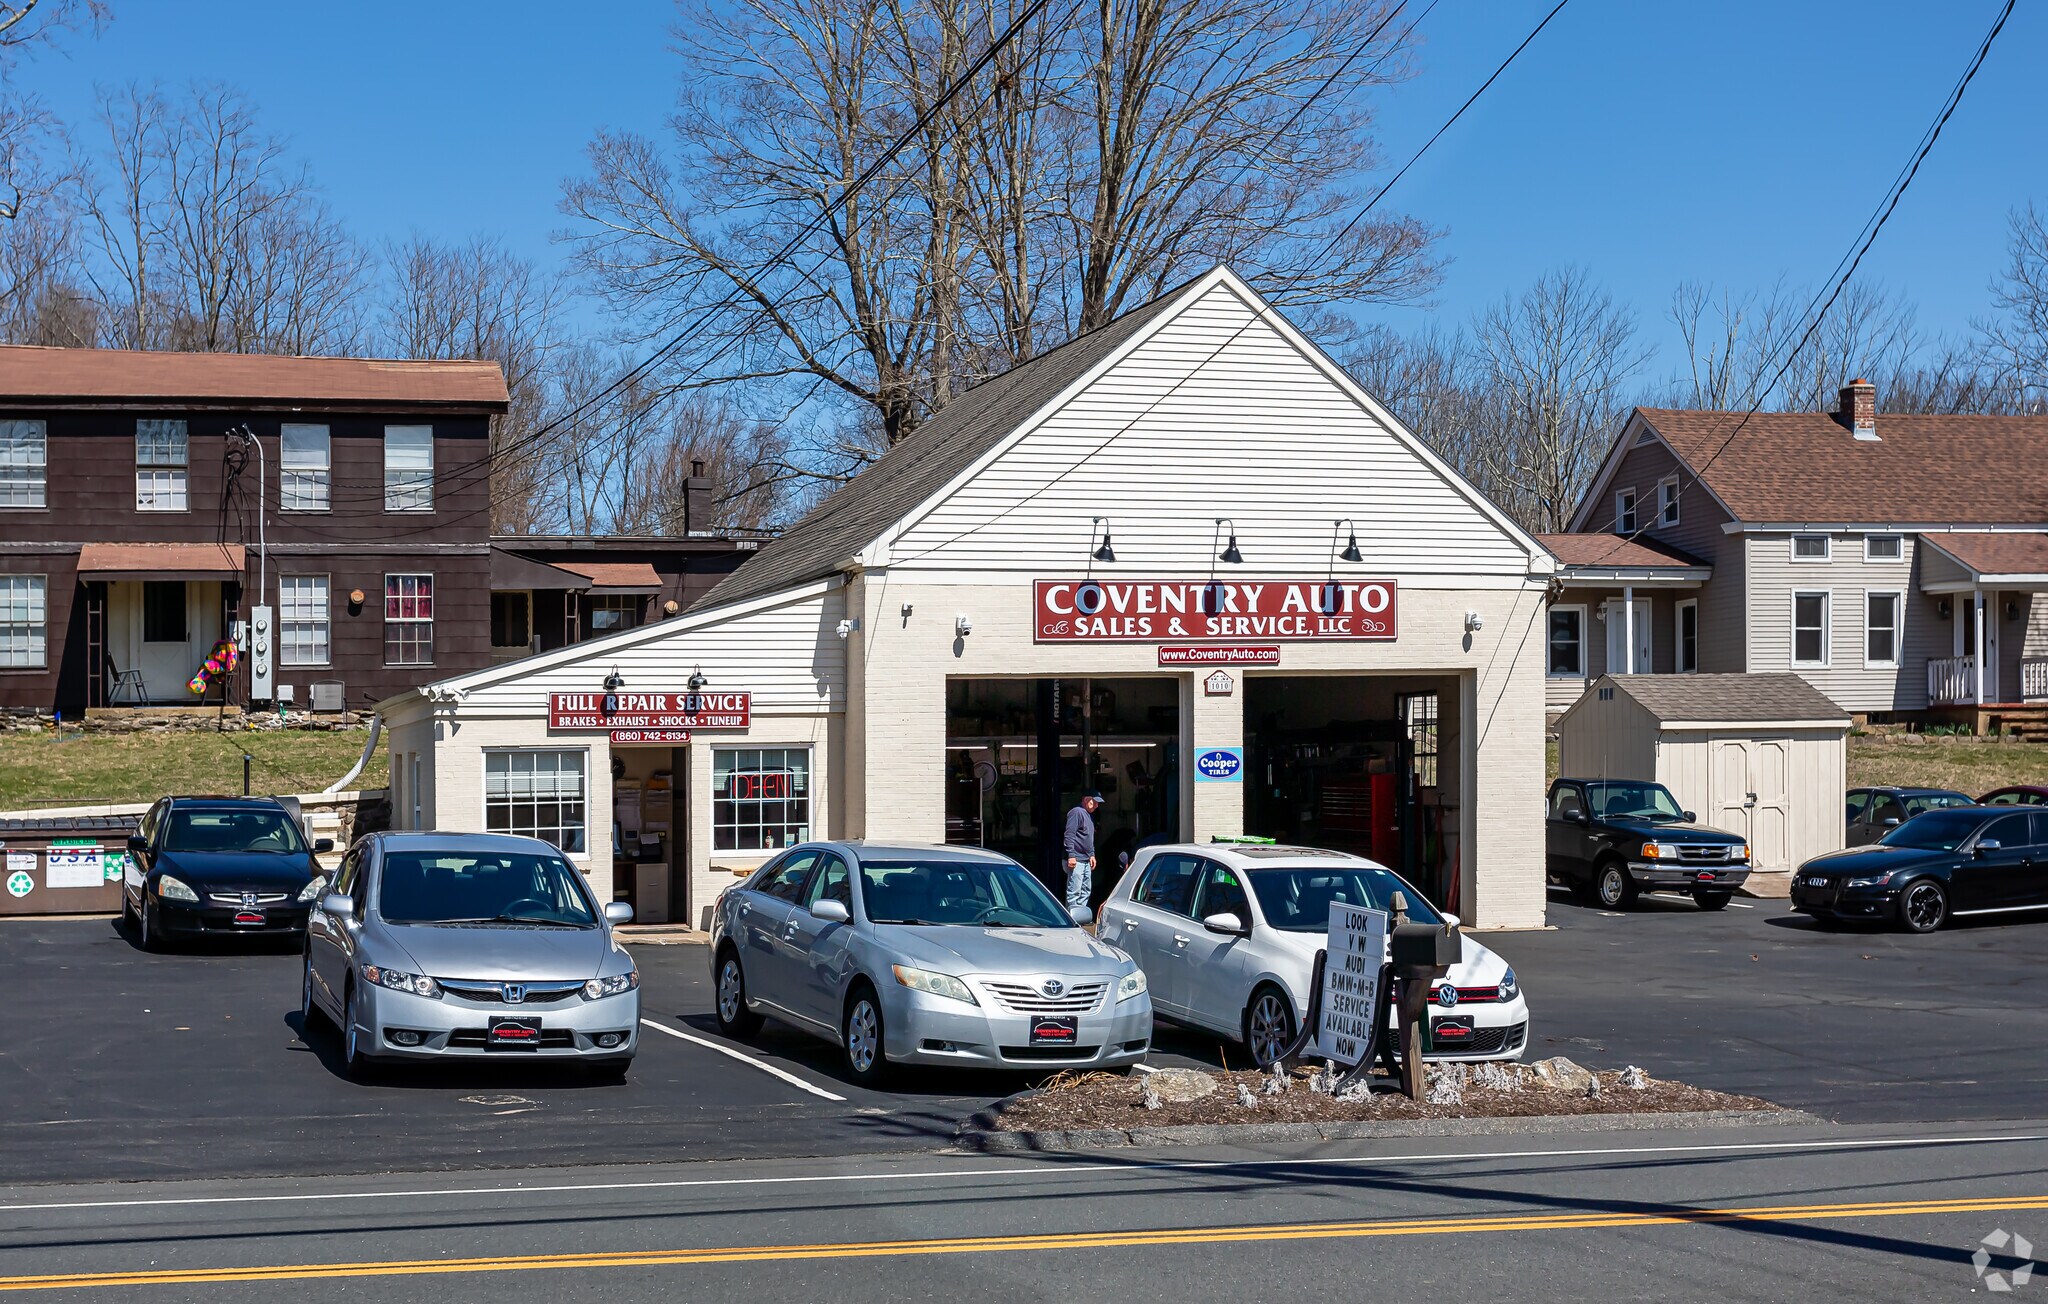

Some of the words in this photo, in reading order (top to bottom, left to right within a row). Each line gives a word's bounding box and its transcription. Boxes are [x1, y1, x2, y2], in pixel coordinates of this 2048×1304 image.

[1045, 584, 1264, 615] COVENTRY
[1280, 584, 1390, 614] AUTO
[1074, 617, 1152, 636] SALES
[1167, 616, 1190, 636] &
[1206, 616, 1314, 637] SERVICE,
[1318, 618, 1351, 633] LLC
[1162, 648, 1278, 661] www.CoventryAuto.com
[1211, 682, 1229, 690] 1010
[557, 695, 597, 711] FULL
[606, 695, 667, 711] REPAIR
[676, 695, 744, 711] SERVICE
[558, 716, 597, 726] BRAKES
[606, 716, 650, 726] EXHAUST
[658, 716, 697, 726] SHOCKS
[706, 716, 743, 726] TUNEUP
[615, 731, 641, 741] (860)
[643, 731, 687, 741] 742-6134
[1200, 758, 1238, 770] Cooper
[1345, 911, 1368, 933] LOOK
[1345, 954, 1366, 975] AUDI
[1333, 993, 1370, 1019] SERVICE
[1335, 1036, 1356, 1058] NOW
